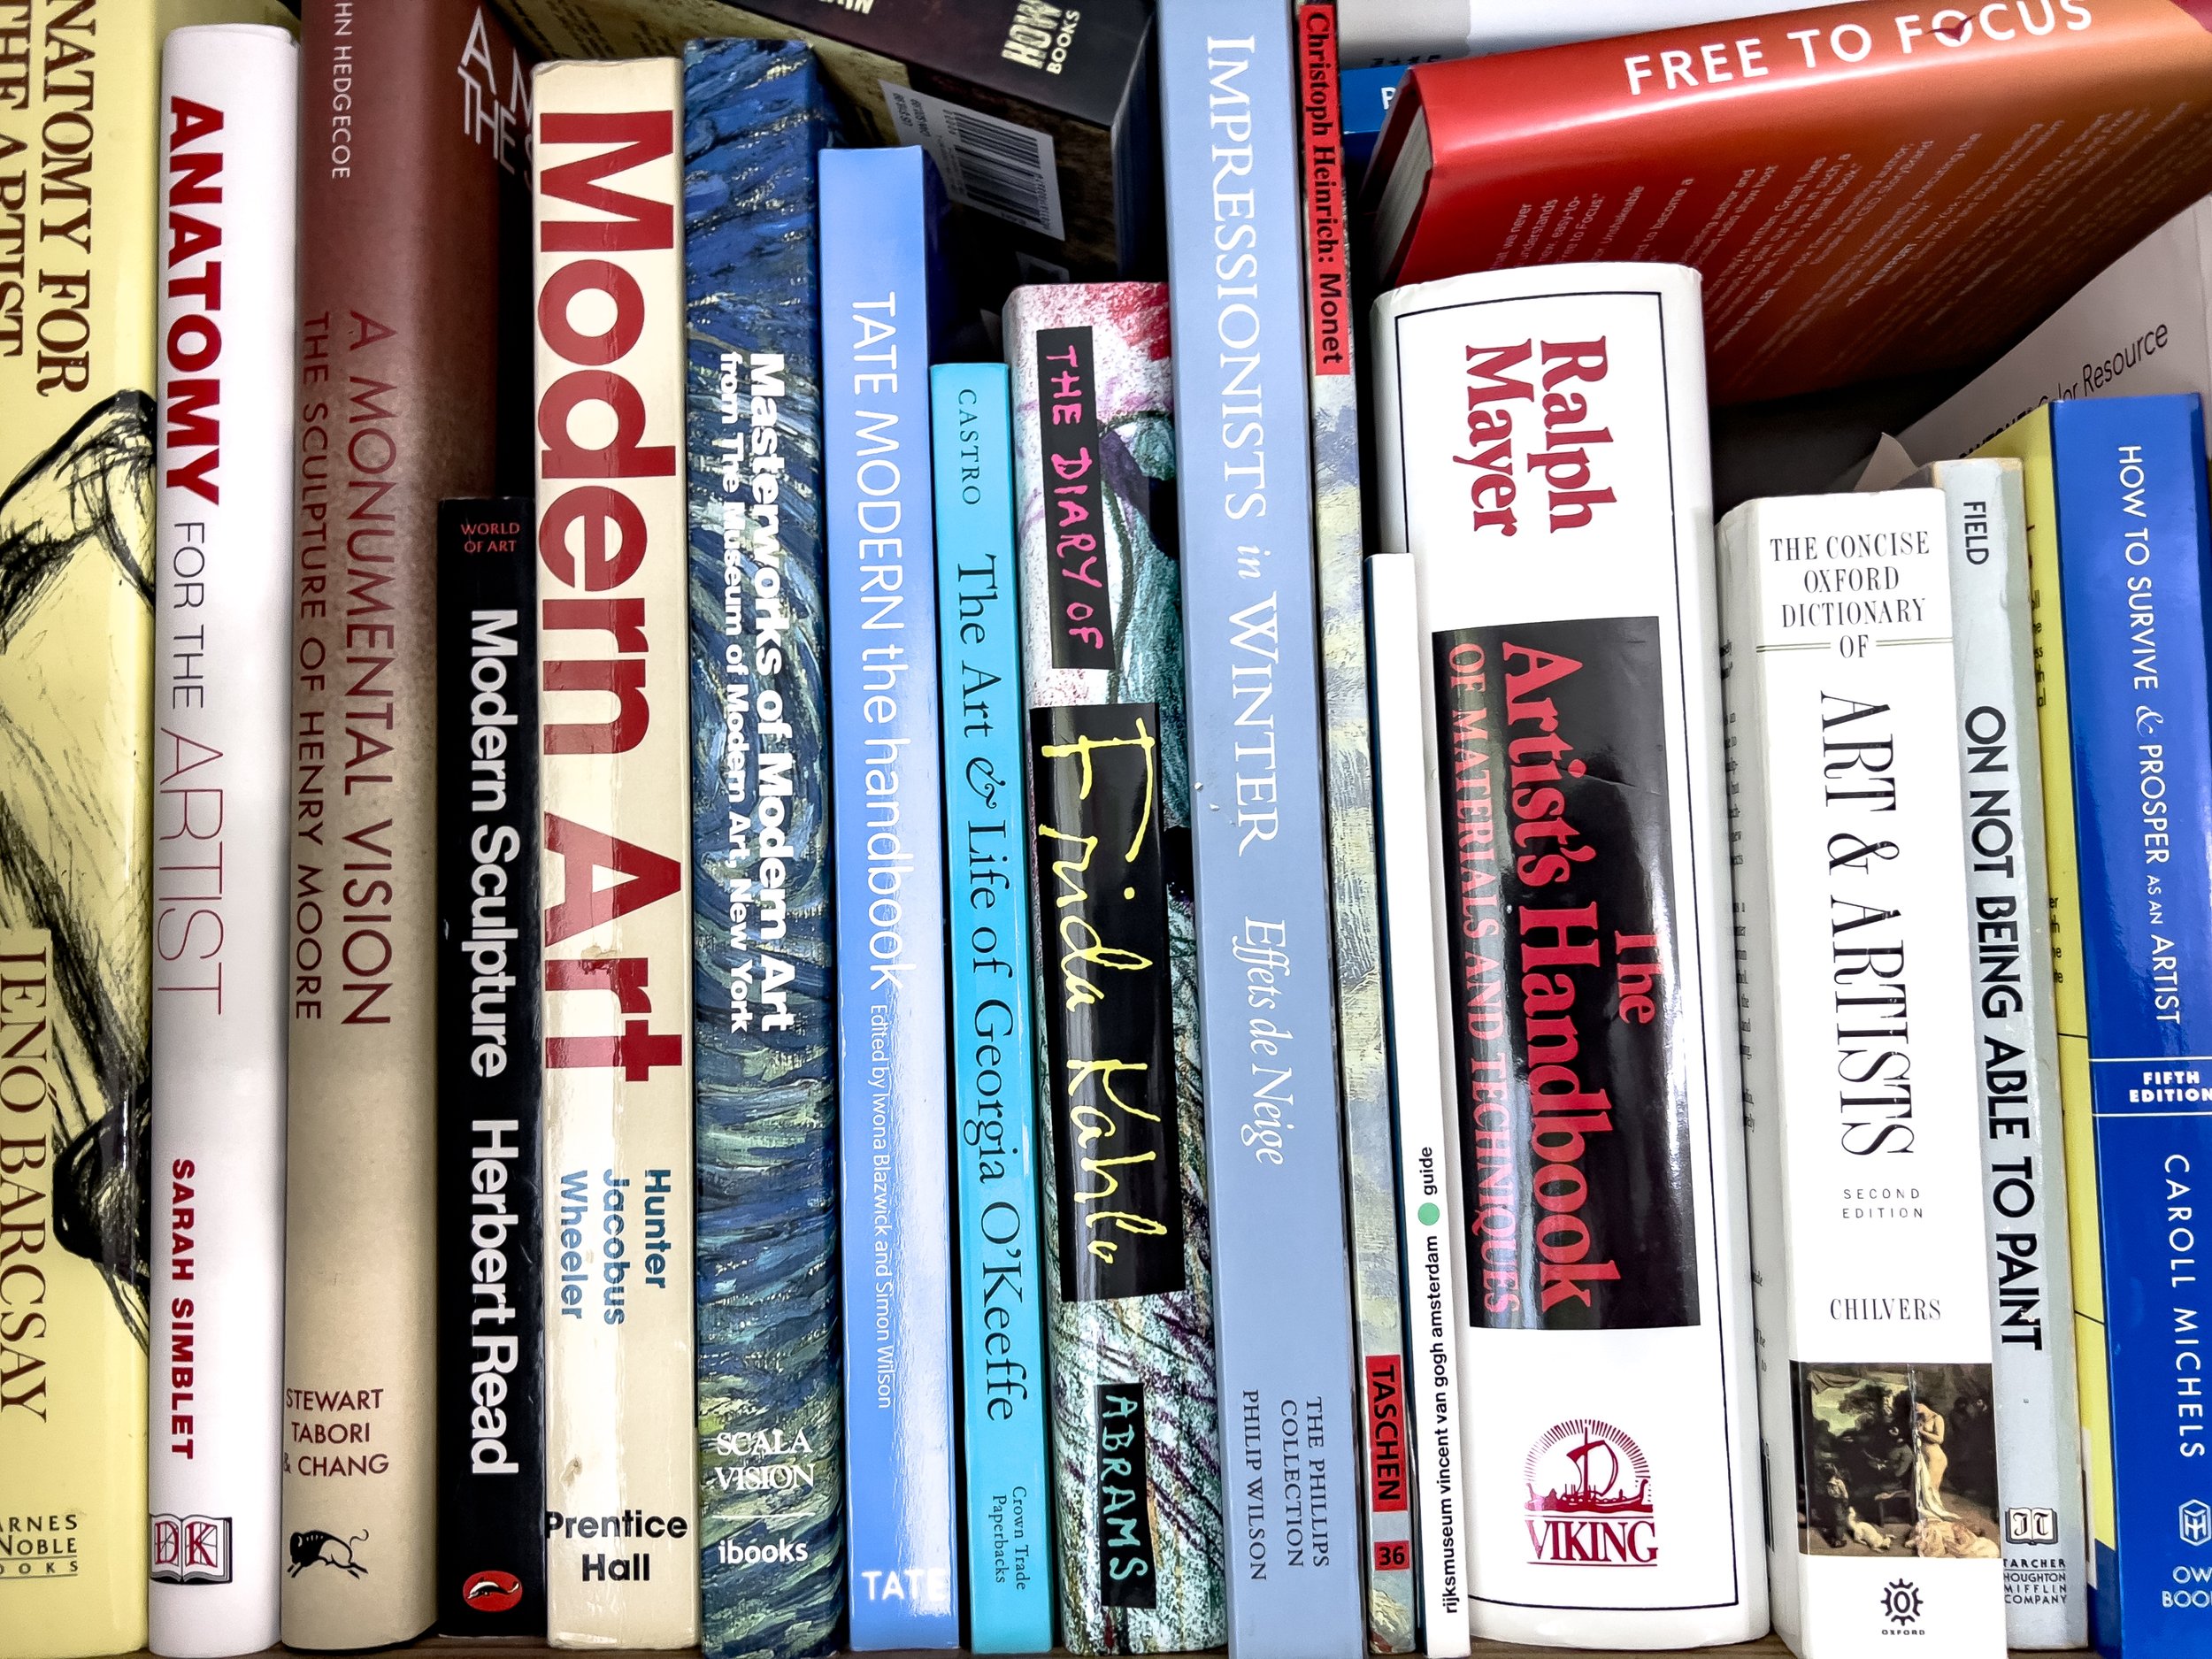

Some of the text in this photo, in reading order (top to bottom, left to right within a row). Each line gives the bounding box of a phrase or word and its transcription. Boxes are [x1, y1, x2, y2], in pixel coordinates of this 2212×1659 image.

[1046, 10, 1080, 74] BOOKS
[1624, 0, 2093, 96] FREE TO FOCUS
[332, 45, 353, 180] HEDGECOE
[1303, 12, 1345, 365] Christoph Heinrich: Monet
[36, 268, 91, 397] FOR
[2082, 323, 2169, 397] Resource
[537, 110, 677, 756] Modern
[957, 388, 981, 506] CASTRO
[1452, 338, 1536, 537] Mayer
[1526, 334, 1618, 535] Ralph
[157, 96, 225, 1016] ANATOMY FOR THE ARTIST
[460, 522, 520, 535] WORLD
[464, 540, 517, 553] OF ART
[1045, 344, 1104, 650] THE DIARY OF
[1770, 531, 1930, 562] THE CONCISE
[1962, 501, 1991, 566] FIELD
[1206, 35, 1294, 1167] IMPRESSIONISTS in WINTER Effets de Neige
[1781, 597, 1926, 628] DICTIONARY
[1803, 566, 1900, 594] OXFORD
[295, 311, 330, 1020] THE SCULPTURE OF HENRY MOORE
[340, 309, 398, 1027] A MONUMENTAL VISION
[718, 350, 753, 1034] from The Museum of Modern Art, New York
[749, 352, 796, 1033] Masterworks of Modern Art
[1839, 634, 1870, 660] OF
[2118, 444, 2182, 1025] HOW TO SURVIVE & PROSPER AS AN ARTIST
[851, 290, 918, 1409] TATE MODERN the handbook Edited by Iwona Blazwick and Simon Wilson
[542, 810, 682, 1081] Art
[1448, 641, 1521, 1315] OF MATERIALS AND TECHNIQUES
[1502, 641, 1622, 1313] Artist’s Handbook
[1819, 689, 1916, 1157] ART & ARTISTS
[461, 610, 521, 1476] Modern Sculpture Herbert Read
[957, 554, 1028, 1422] The Art & Life of Georgia O’Keeffe
[1038, 717, 1168, 1265] Frida Kahlo
[1964, 705, 2043, 1351] ON NOT BEING ABLE TO PAINT
[2129, 1088, 2212, 1103] EDITION
[2143, 1071, 2200, 1086] FIFTH
[558, 1169, 589, 1321] Wheeler
[602, 1168, 631, 1326] Jacobus
[643, 1168, 672, 1290] Hunter
[1842, 1206, 1924, 1220] EDITION
[1843, 1187, 1922, 1202] SECOND
[0, 1133, 49, 1424] BARCSAY
[170, 1158, 196, 1460] SARAH SIMBLET
[1830, 1297, 1942, 1322] CHILVERS
[2164, 1154, 2206, 1458] CAROLL MICHELS
[286, 1387, 384, 1412] STEWART
[291, 1421, 370, 1444] TABORI
[716, 1427, 814, 1456] SCALA
[1371, 1363, 1402, 1502] TASCHEN
[1417, 1146, 1460, 1615] rijksmuseum vincent van gogh amsterdam guide
[297, 1454, 389, 1477] CHANG
[545, 1509, 688, 1540] Prentice
[716, 1463, 816, 1493] VISION
[1101, 1394, 1148, 1581] ABRAMS
[1242, 1388, 1268, 1581] PHILIP WILSON
[1280, 1399, 1304, 1568] COLLECTION
[1306, 1395, 1330, 1568] THE PHILLIPS
[154, 1520, 219, 1569] DK
[581, 1553, 650, 1582] Hall
[718, 1538, 809, 1566] ibooks
[861, 1569, 948, 1602] TATE
[988, 1494, 1010, 1584] Paperbacks
[1012, 1486, 1031, 1591] Crown Trade
[1378, 1545, 1407, 1567] 36
[1525, 1519, 1658, 1565] VIKING
[2003, 1558, 2066, 1569] TARCHER
[2003, 1572, 2066, 1583] HOUGHTON
[2003, 1582, 2067, 1593] MIFFLIN
[2004, 1594, 2067, 1605] COMPANY
